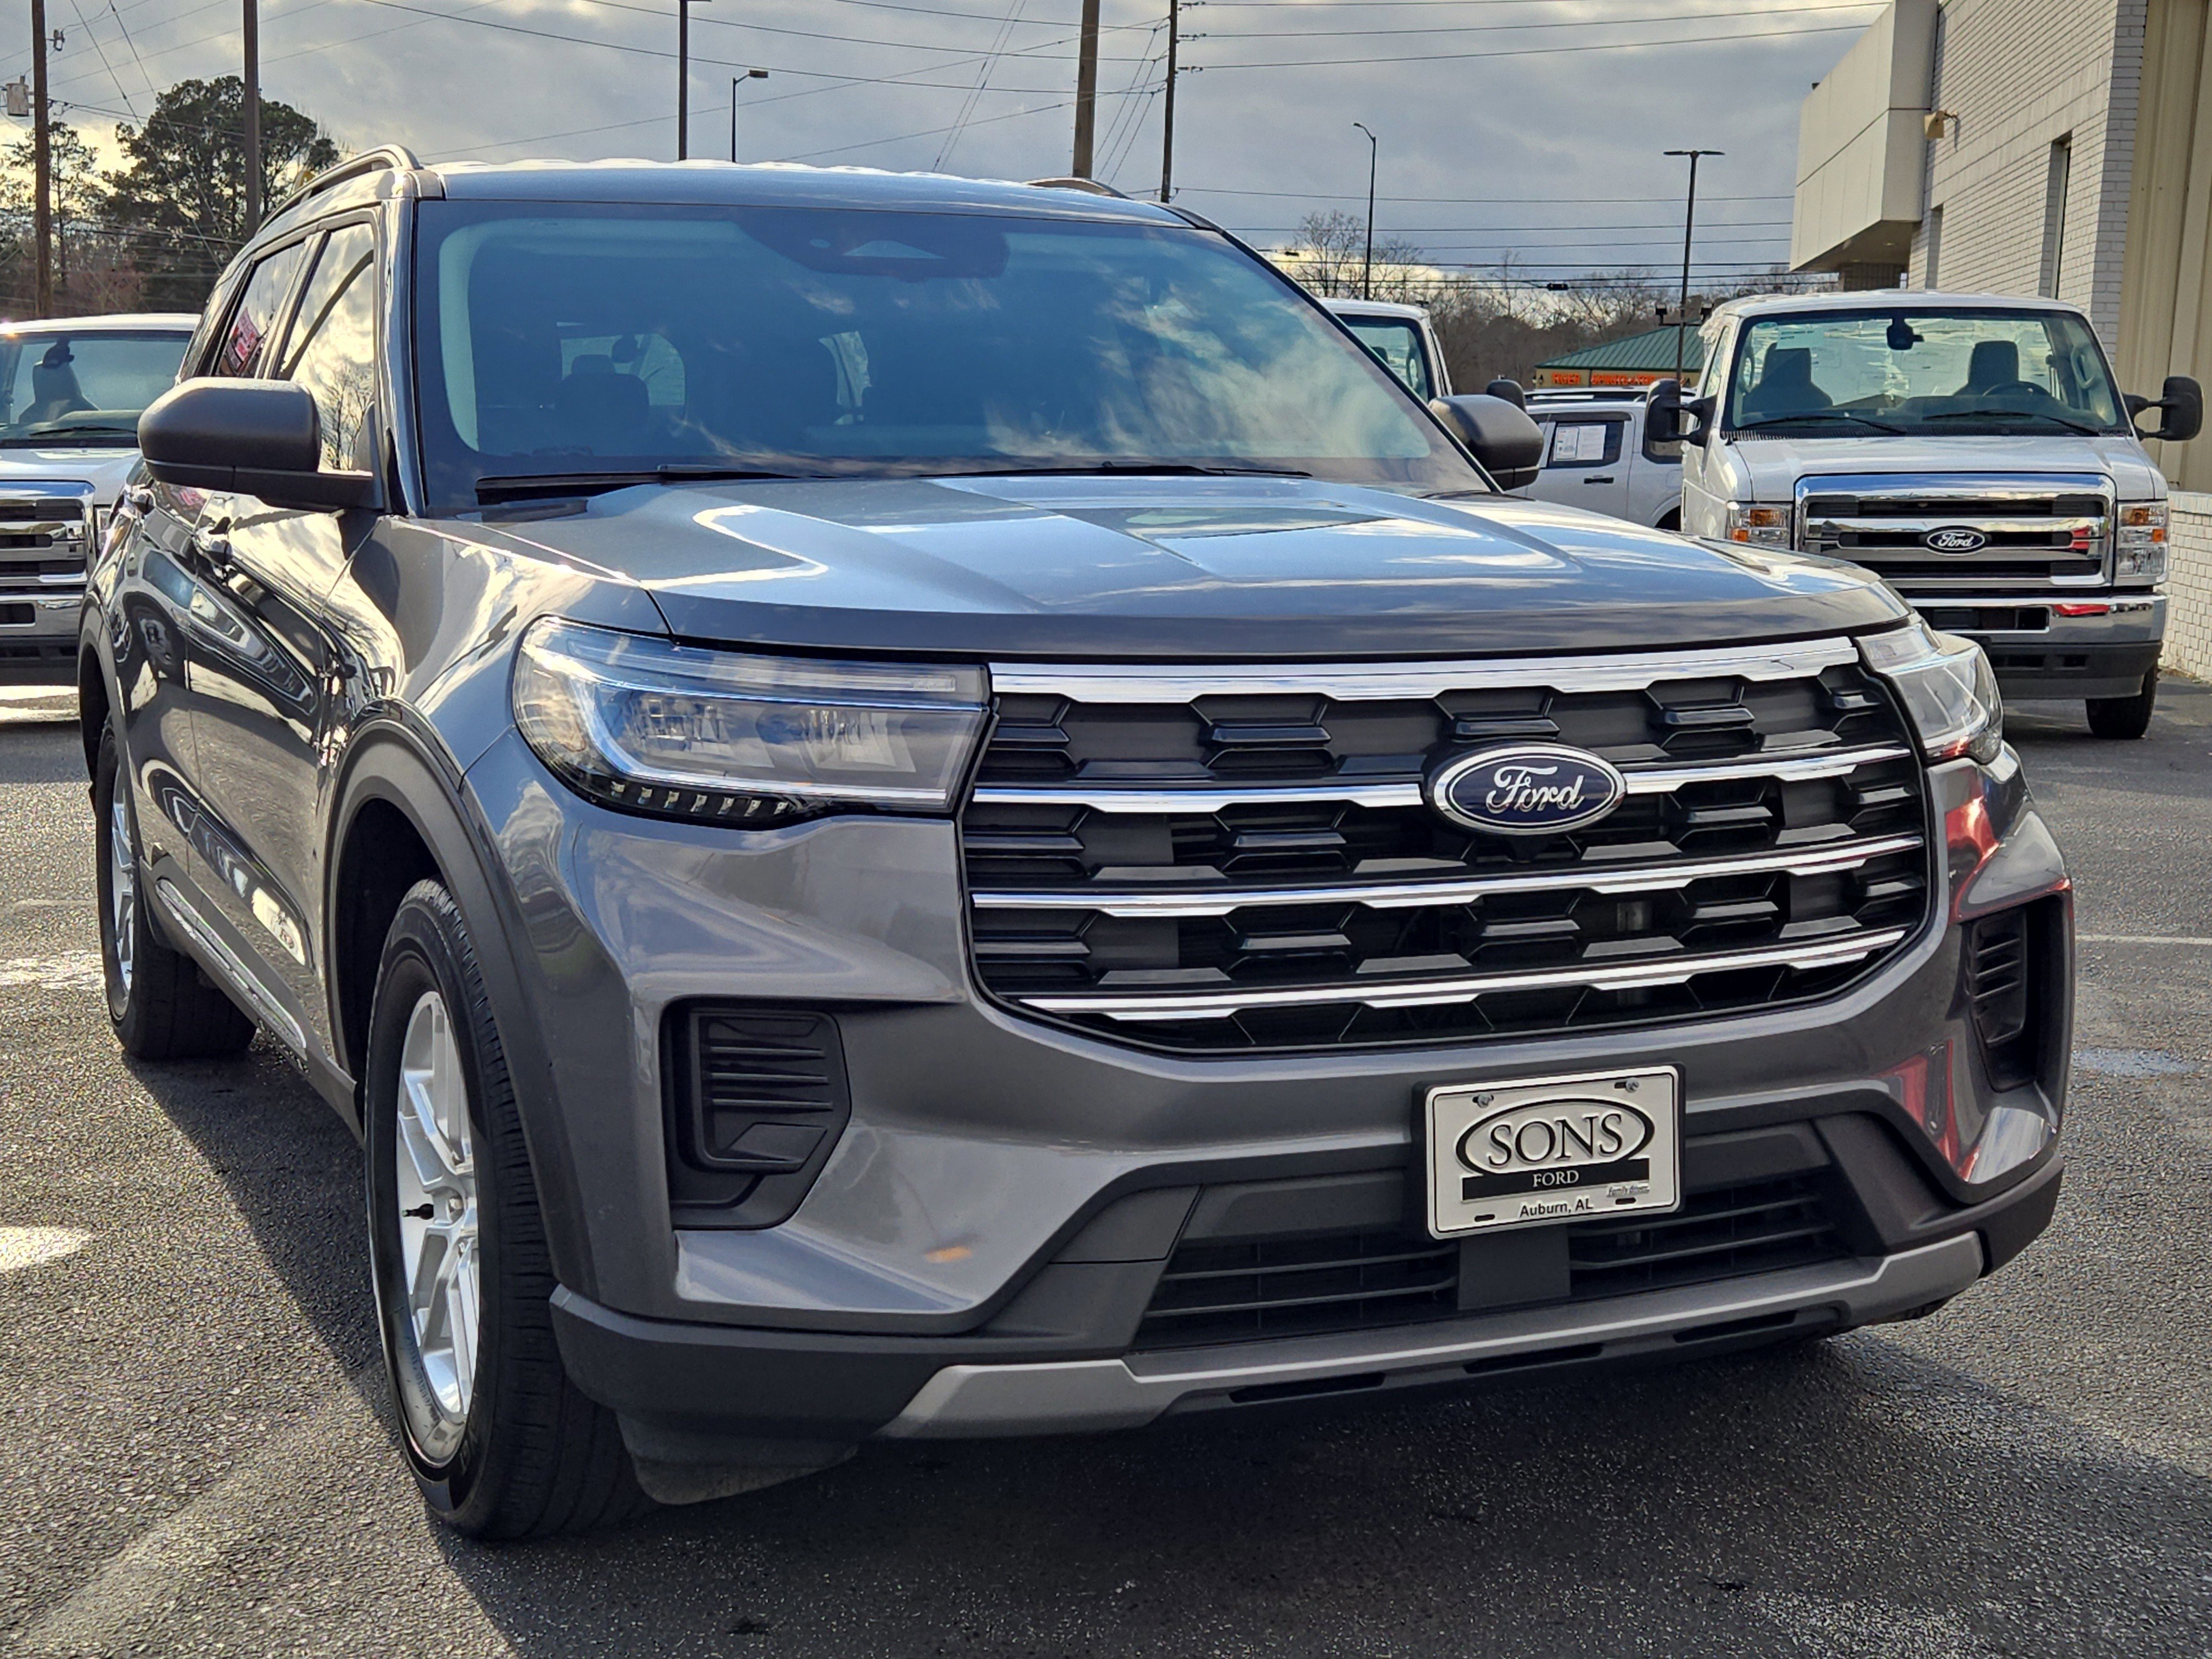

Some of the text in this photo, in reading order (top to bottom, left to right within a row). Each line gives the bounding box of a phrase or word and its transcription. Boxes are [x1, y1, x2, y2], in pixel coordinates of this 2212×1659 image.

[1938, 532, 1973, 546] Ford
[1486, 766, 1584, 813] Ford
[1488, 1114, 1622, 1166] SONS
[1533, 1171, 1579, 1186] FORD
[1520, 1199, 1593, 1217] Auburn, AL
